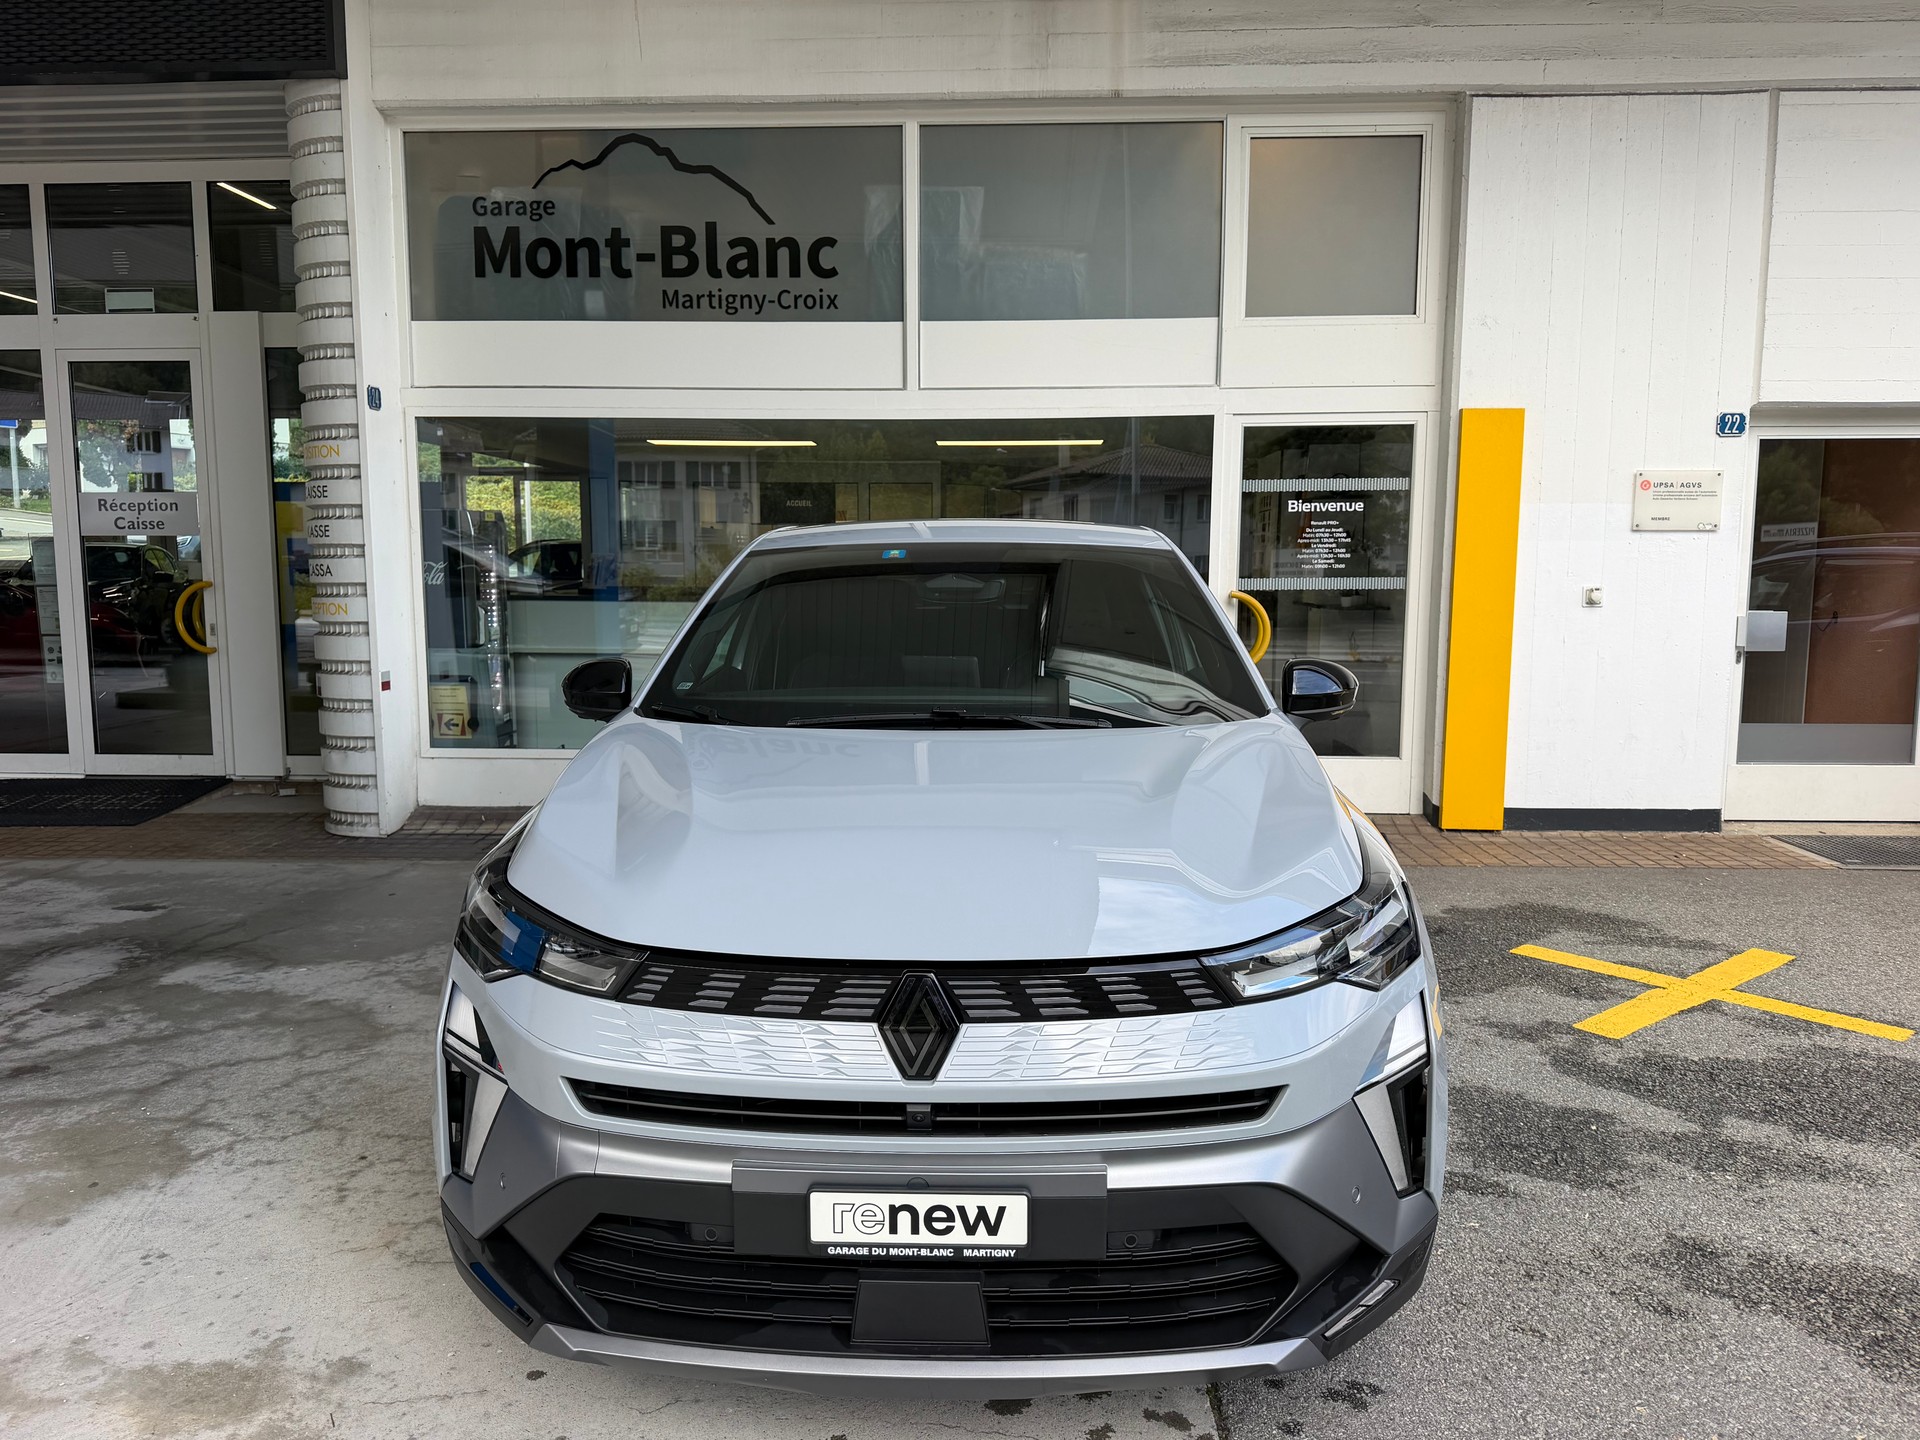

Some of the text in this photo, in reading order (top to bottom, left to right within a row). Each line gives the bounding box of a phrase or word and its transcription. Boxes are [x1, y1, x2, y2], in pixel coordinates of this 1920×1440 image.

[472, 196, 556, 222] Garage
[473, 221, 839, 280] Mont-Blanc
[662, 288, 839, 315] Martigny-Croix
[1724, 414, 1741, 434] 22
[97, 498, 179, 516] Réception
[786, 499, 813, 507] ACCUEIL
[1288, 500, 1364, 512] Bienvenue
[114, 516, 165, 530] Caisse
[308, 524, 330, 538] ASSE
[310, 563, 333, 577] ASSA
[833, 1203, 1007, 1236] renew
[827, 1246, 1016, 1258] GARAGE DU MONT-BLANC MARTIGNY
